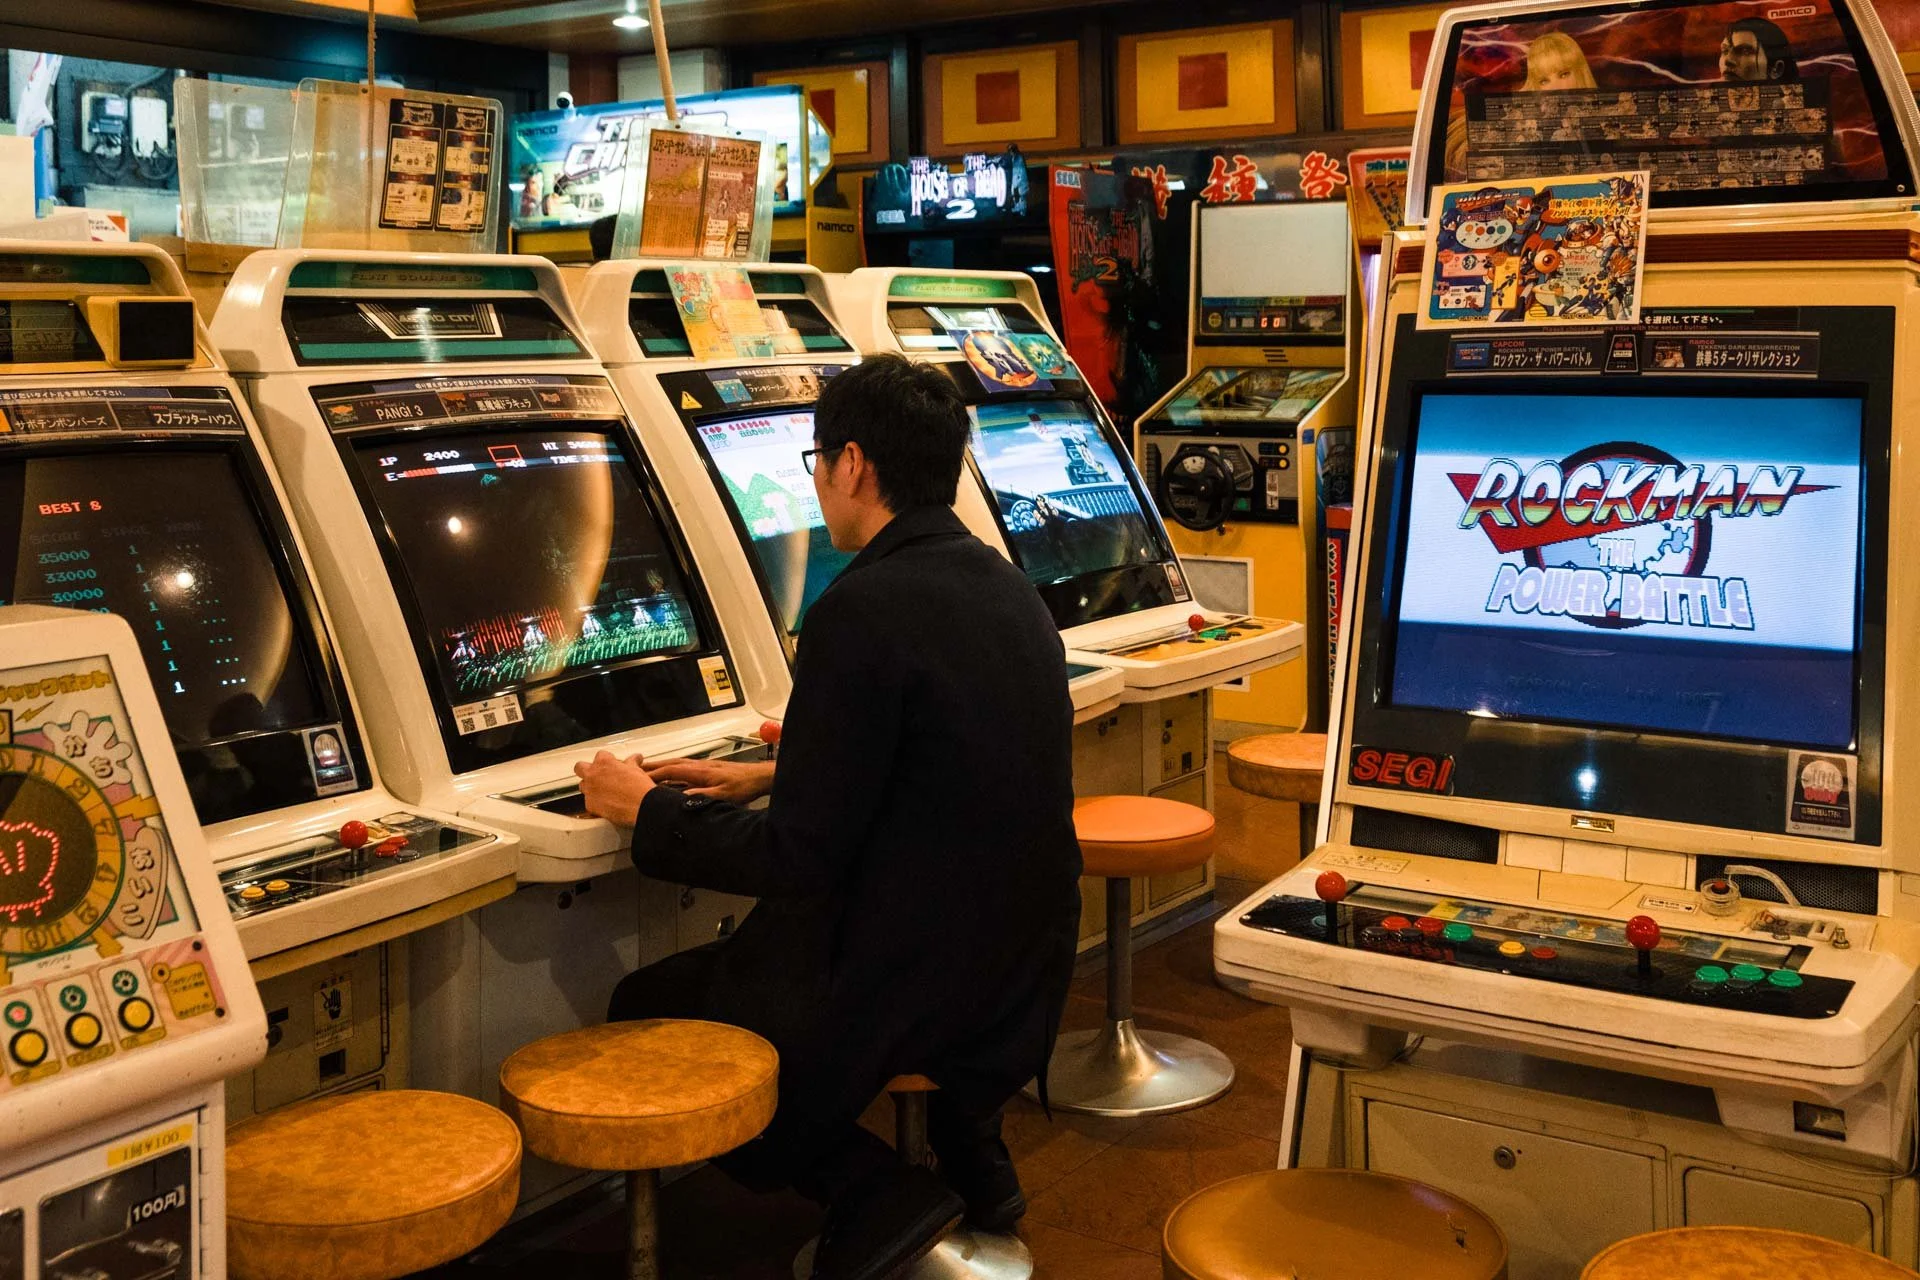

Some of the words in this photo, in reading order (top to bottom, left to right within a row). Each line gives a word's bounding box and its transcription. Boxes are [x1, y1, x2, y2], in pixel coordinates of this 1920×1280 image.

[1769, 6, 1815, 18] namco
[911, 158, 930, 175] THE
[967, 154, 986, 171] THE
[974, 164, 1007, 207] DEAD
[1056, 170, 1081, 188] SEGA
[910, 169, 949, 217] HOUSE
[876, 210, 905, 224] SEGA
[946, 198, 978, 220] 2
[816, 220, 855, 234] namco
[1093, 256, 1120, 281] 2
[448, 313, 475, 322] CITY
[1640, 315, 1724, 325] を選択して下さい。
[375, 405, 413, 420] PANG!
[414, 405, 424, 416] 3
[541, 442, 559, 451] HI
[379, 456, 398, 467] 1P
[423, 450, 460, 461] 2400
[1457, 457, 1805, 529] ROCKMAN
[39, 501, 81, 516] BEST
[38, 550, 91, 564] 35000
[1598, 538, 1635, 569] THE
[45, 568, 97, 584] 33000
[51, 588, 104, 603] 30000
[1486, 563, 1608, 618] POWER
[1615, 571, 1755, 631] BATTLE
[1353, 750, 1453, 791] SEGI
[132, 1191, 177, 1222] 100円
